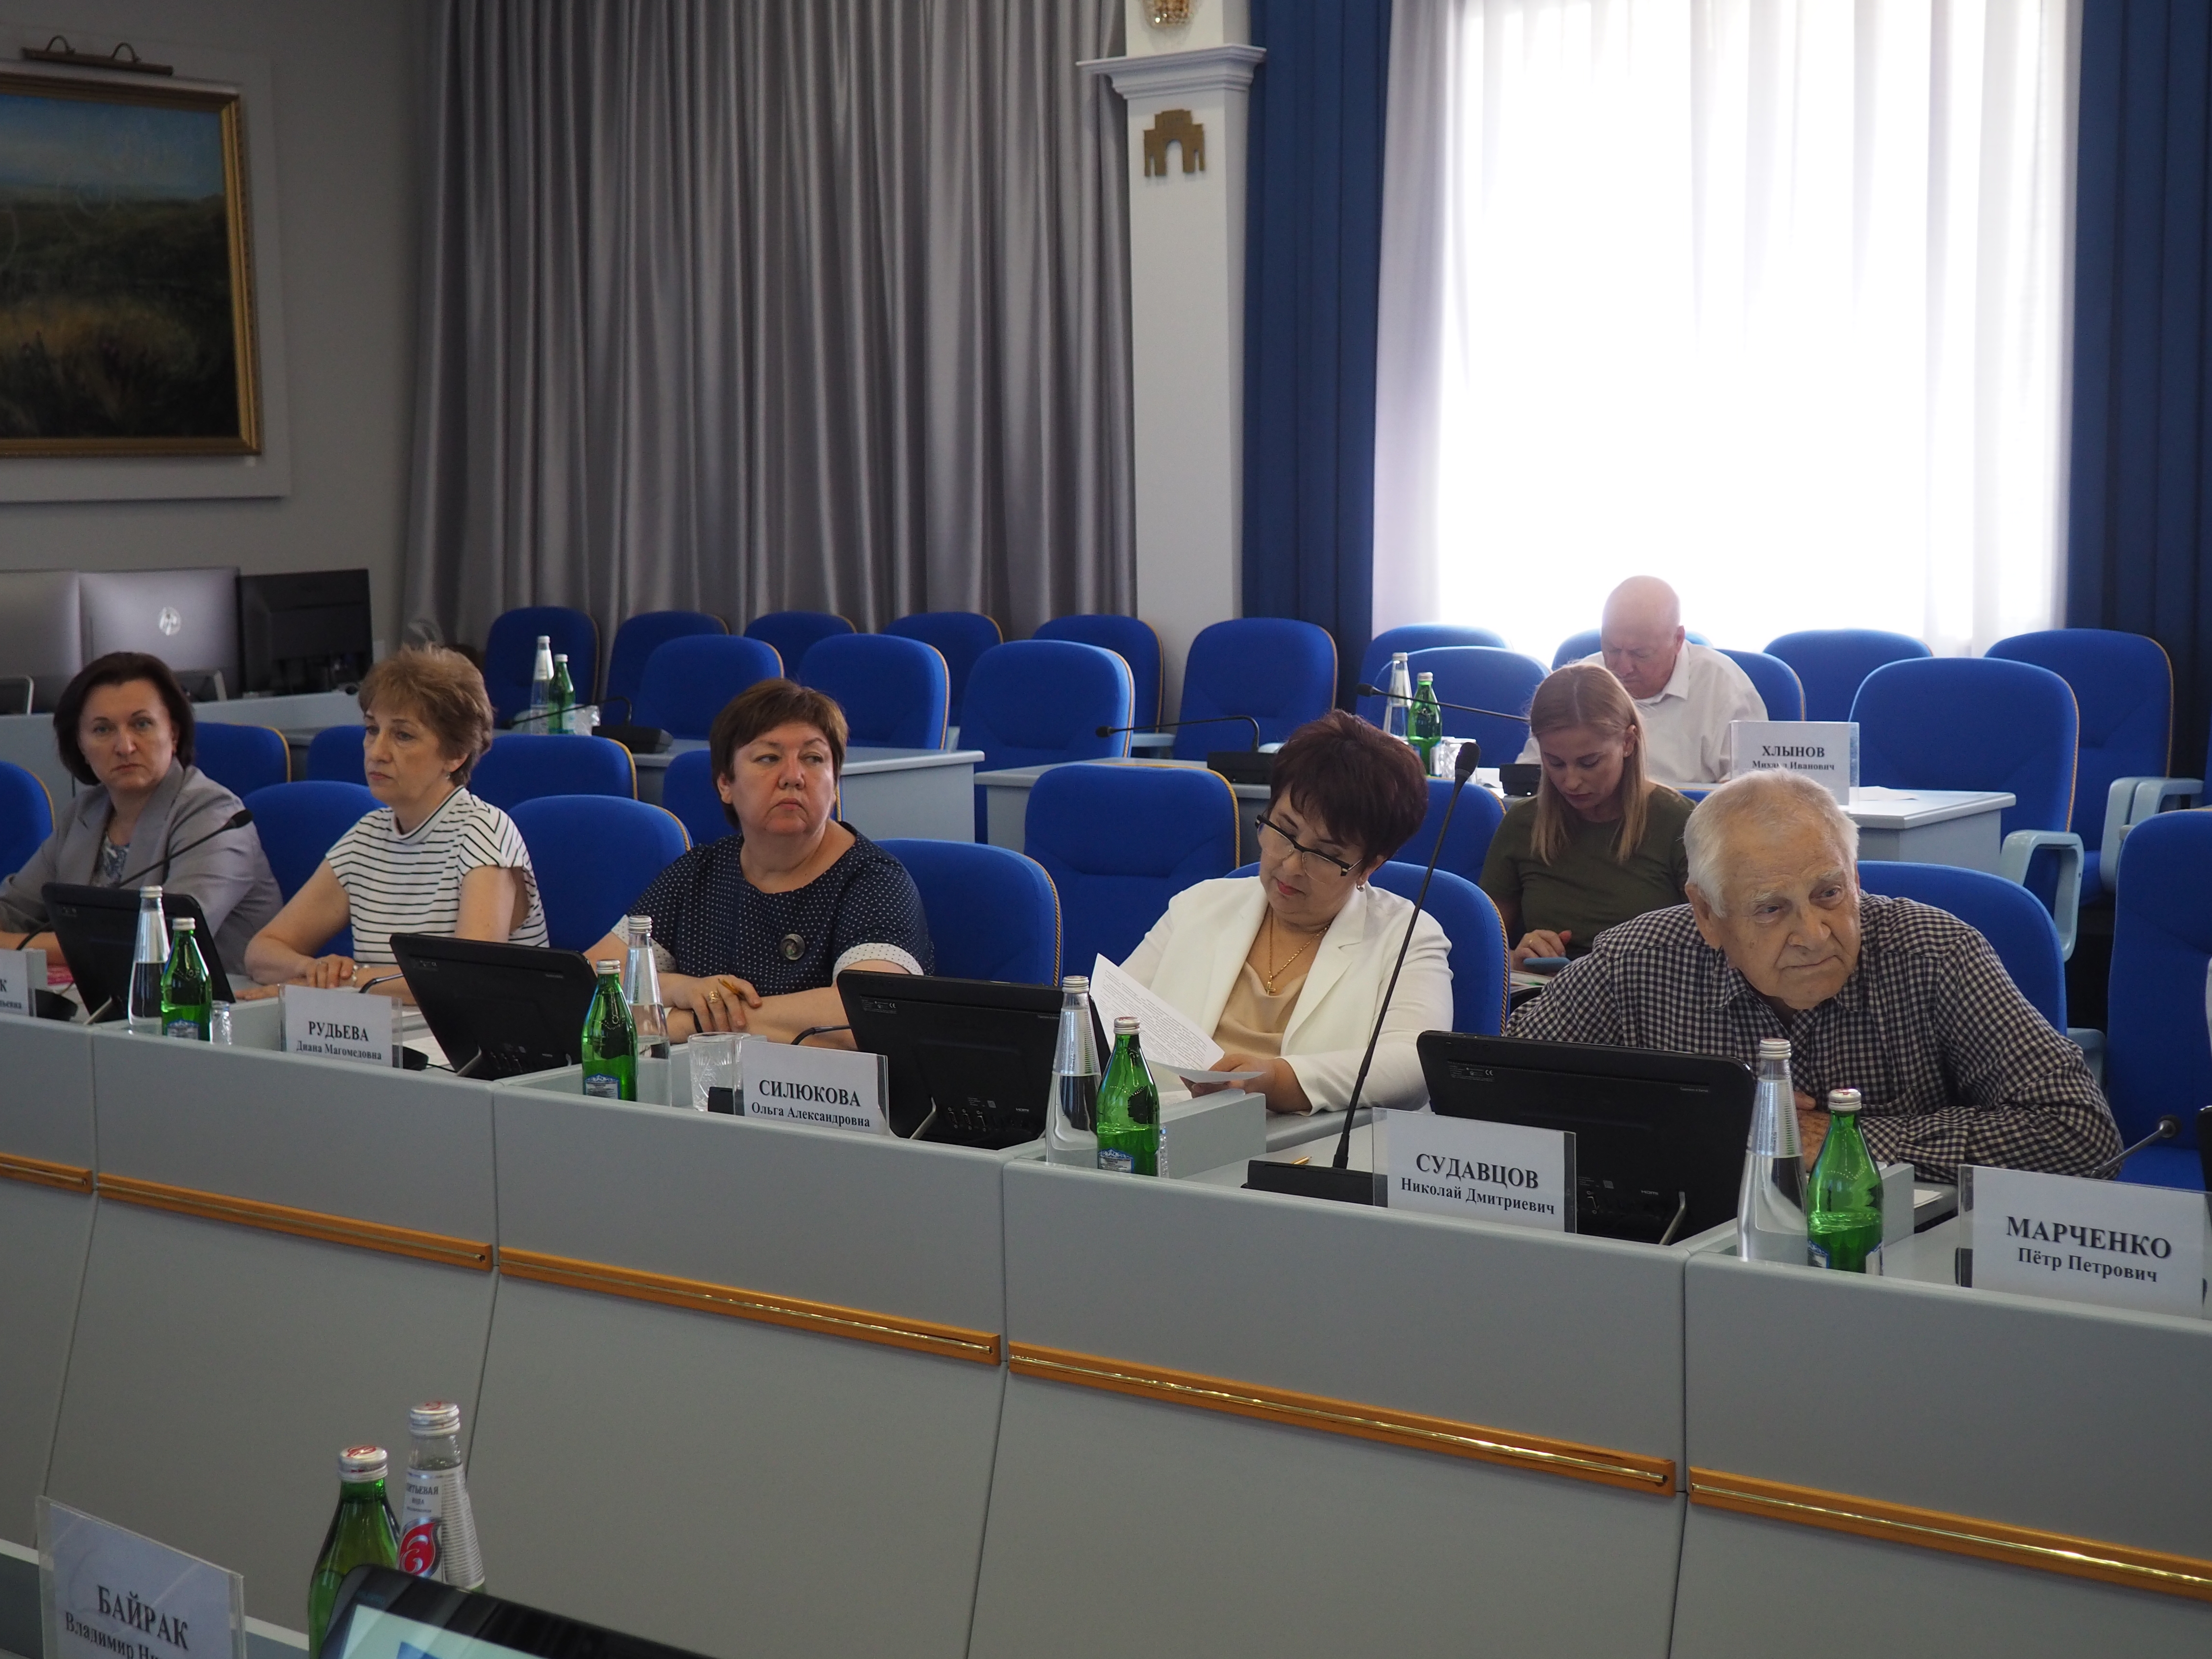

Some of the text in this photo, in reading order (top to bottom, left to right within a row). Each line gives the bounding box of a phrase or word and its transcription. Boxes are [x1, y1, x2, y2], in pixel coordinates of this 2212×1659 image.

[1752, 760, 1835, 770] Михал Иванович
[1762, 745, 1825, 757] ХЛЫНОВ
[308, 1021, 369, 1042] РУДЬЕВА
[296, 1040, 382, 1060] Диана Магомедовна
[759, 1080, 861, 1107] СИЛЮКОВА
[751, 1102, 870, 1127] Ольга Александровна
[1416, 1153, 1539, 1189] СУДАВЦОВ
[1400, 1177, 1555, 1215] Николай Дмитриевич
[2006, 1215, 2172, 1260] МАРЧЕНКО
[2017, 1247, 2158, 1283] Пётр Петрович
[97, 1584, 189, 1651] БАЙРАК
[65, 1611, 134, 1659] Владимир
